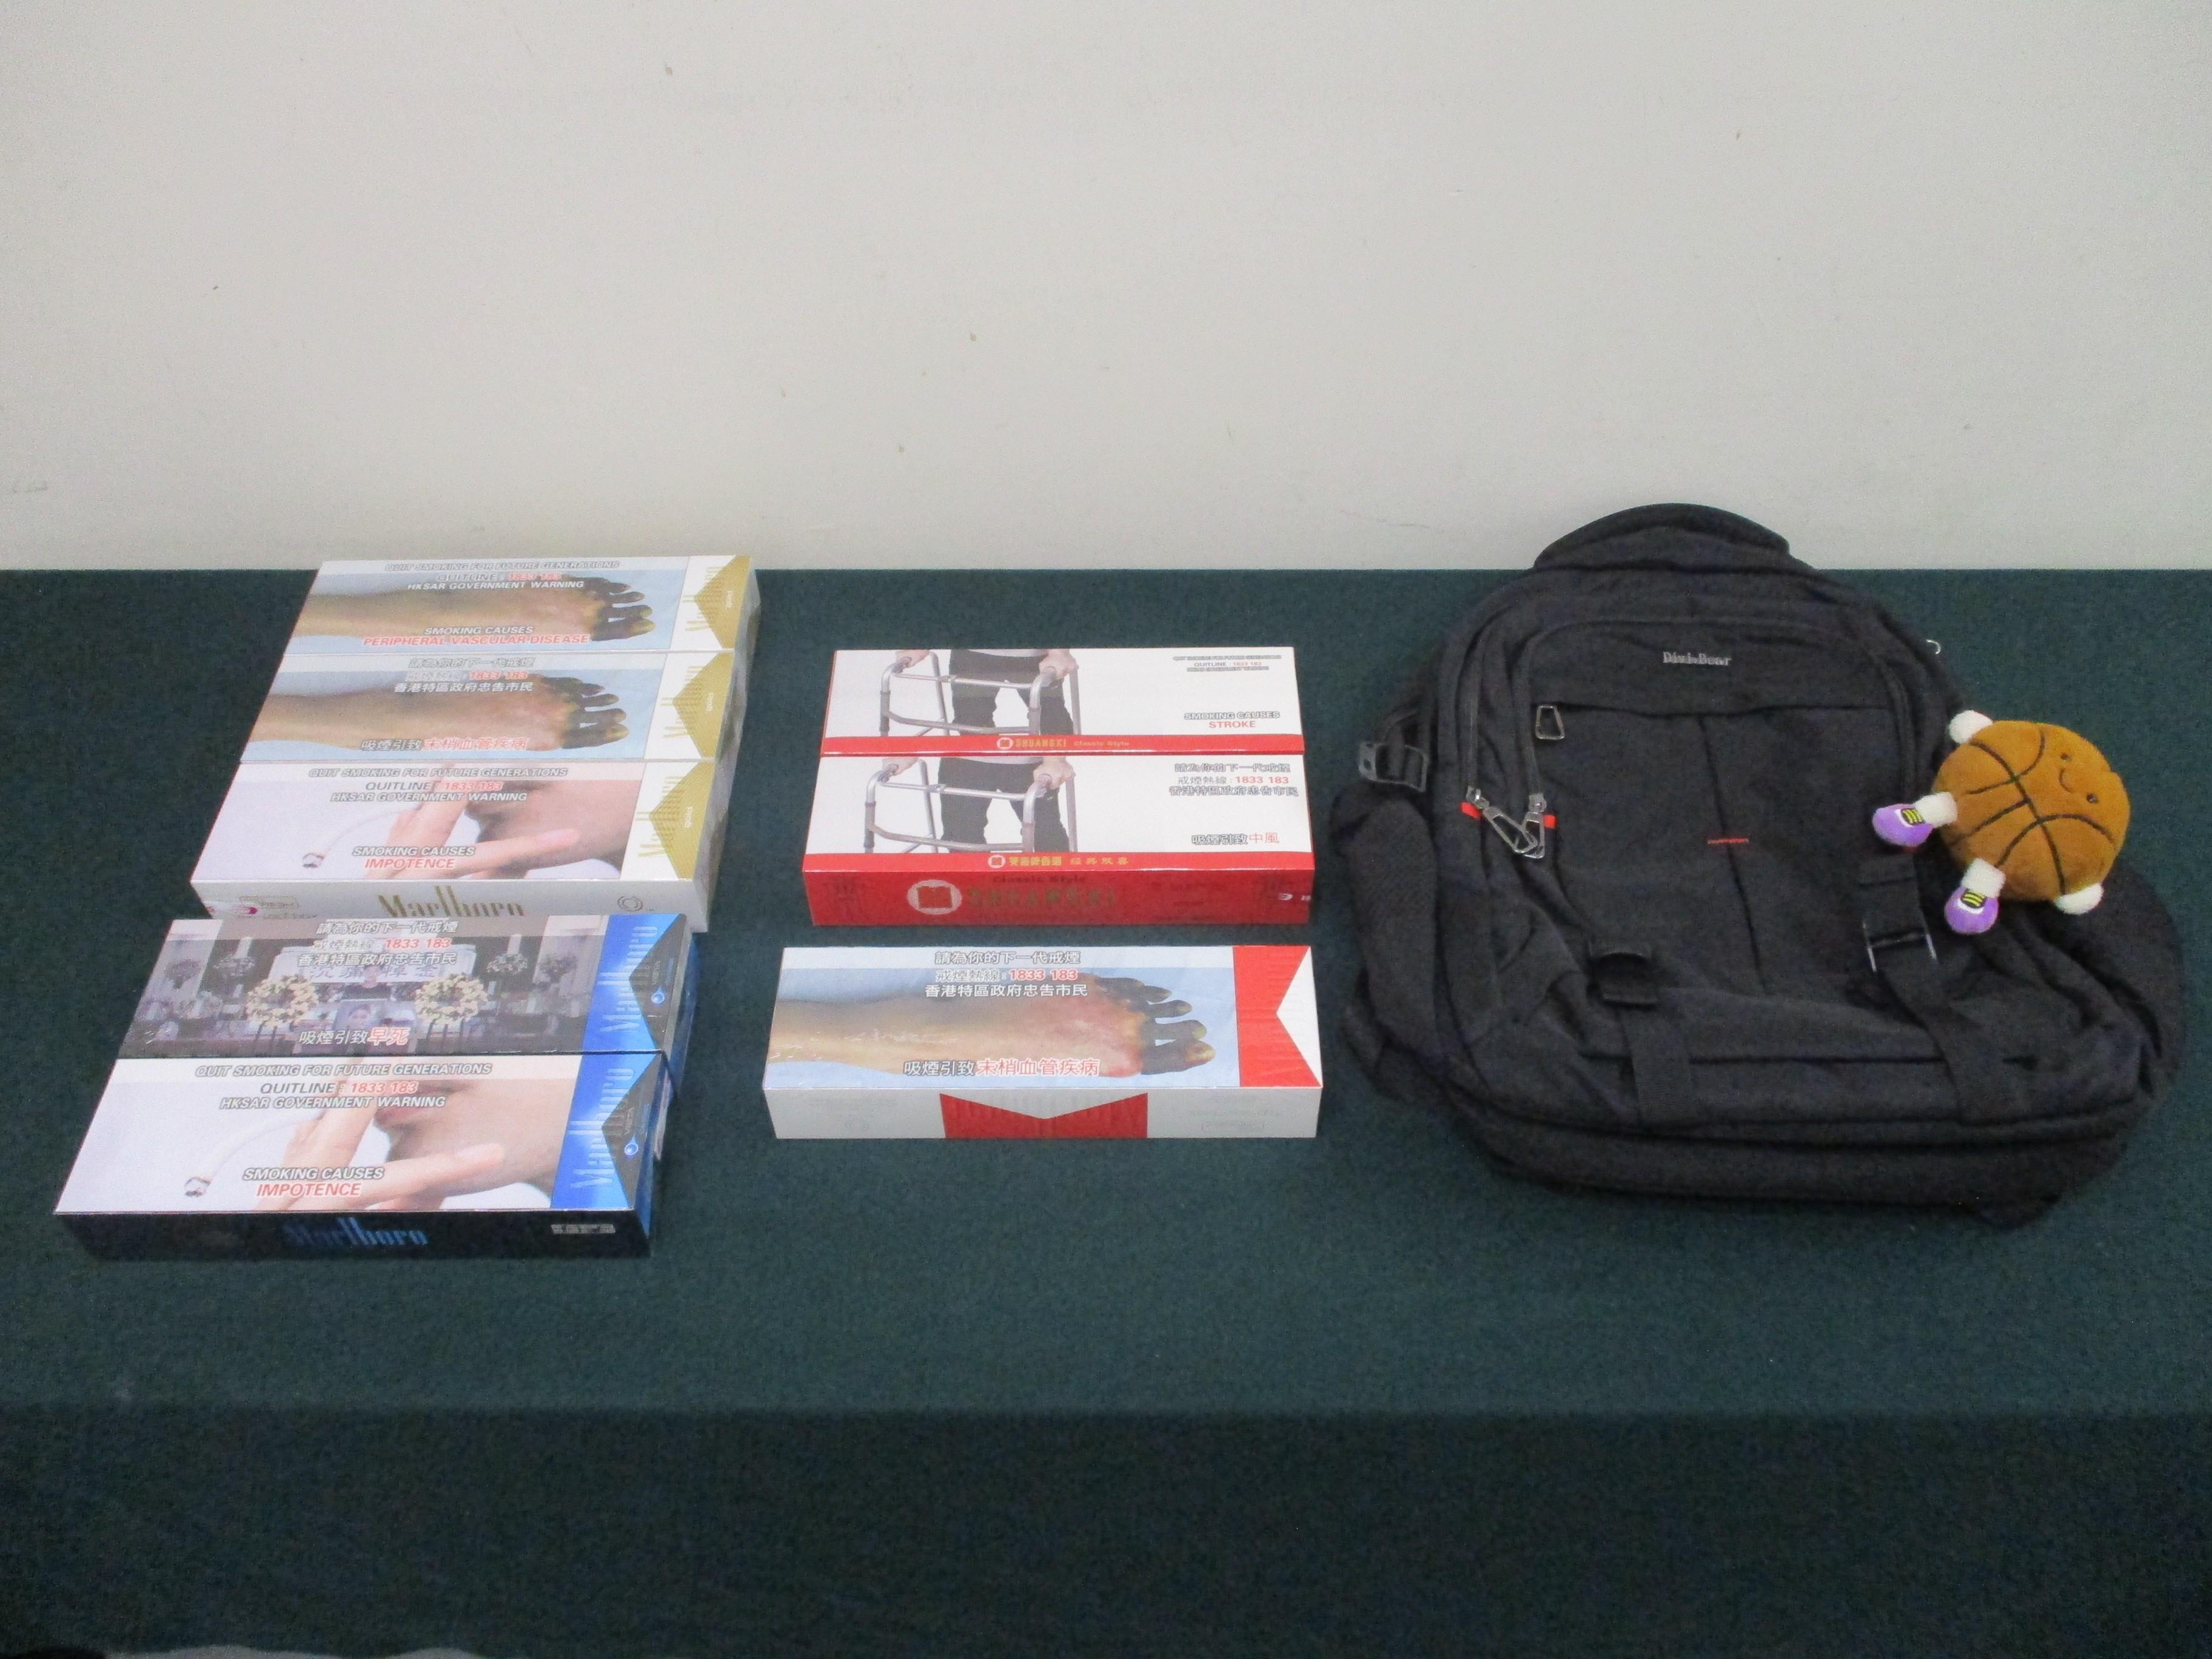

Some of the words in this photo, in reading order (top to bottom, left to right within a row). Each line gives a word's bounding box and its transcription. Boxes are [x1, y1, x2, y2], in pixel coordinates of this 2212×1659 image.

[415, 562, 469, 571] SMOKING
[471, 562, 494, 571] FOR
[496, 561, 537, 570] FUTURE
[541, 561, 619, 570] GENERATIONS
[407, 582, 447, 591] HKSAR
[449, 581, 525, 590] GOVERNMENT
[424, 626, 481, 635] SMOKING
[485, 626, 534, 635] CAUSES
[364, 636, 446, 647] PERIPHERAL
[450, 635, 527, 646] VASCULAR
[531, 634, 590, 645] DISEASE
[394, 682, 534, 693] 香港特區政府忠告市民
[1237, 711, 1281, 720] CAUSES
[309, 768, 340, 778] QUIT
[341, 768, 400, 777] SMOKING
[403, 768, 428, 777] FOR
[431, 768, 478, 777] FUTURE
[481, 768, 568, 777] GENERATIONS
[365, 782, 431, 791] QUITLINE
[444, 782, 475, 791] 1833
[478, 782, 504, 791] 183
[330, 793, 374, 802] HKSAR
[377, 793, 463, 802] GOVERNMENT
[468, 793, 528, 802] WARNING
[352, 846, 418, 857] SMOKING
[421, 846, 475, 856] CAUSES
[364, 857, 457, 868] IMPOTENCE
[316, 920, 458, 934] 請為你的下一代戒煙
[384, 938, 419, 949] 1833
[426, 938, 452, 949] 183
[298, 952, 457, 967] 香港特區政府忠告市民
[934, 951, 1081, 965] 請為你的下一代戒煙
[1008, 969, 1046, 981] 1833
[1050, 969, 1078, 981] 183
[925, 984, 1088, 997] 香港特區政府忠告市民
[300, 1027, 410, 1046] 吸煙引致早死
[195, 1065, 232, 1077] QUIT
[233, 1065, 300, 1076] SMOKING
[303, 1065, 332, 1076] FOR
[334, 1064, 390, 1076] FUTURE
[394, 1064, 492, 1075] GENERATIONS
[903, 1057, 1100, 1077] 吸煙引致末梢血管疾病
[260, 1083, 335, 1094] QUITLINE
[350, 1082, 386, 1093] 1833
[391, 1082, 418, 1094] 183
[220, 1097, 271, 1109] HKSAR
[273, 1096, 372, 1109] GOVERNMENT
[377, 1096, 446, 1108] WARNING
[243, 1168, 319, 1181] SMOKING
[321, 1168, 385, 1180] CAUSES
[256, 1182, 361, 1197] IMPOTENCE
